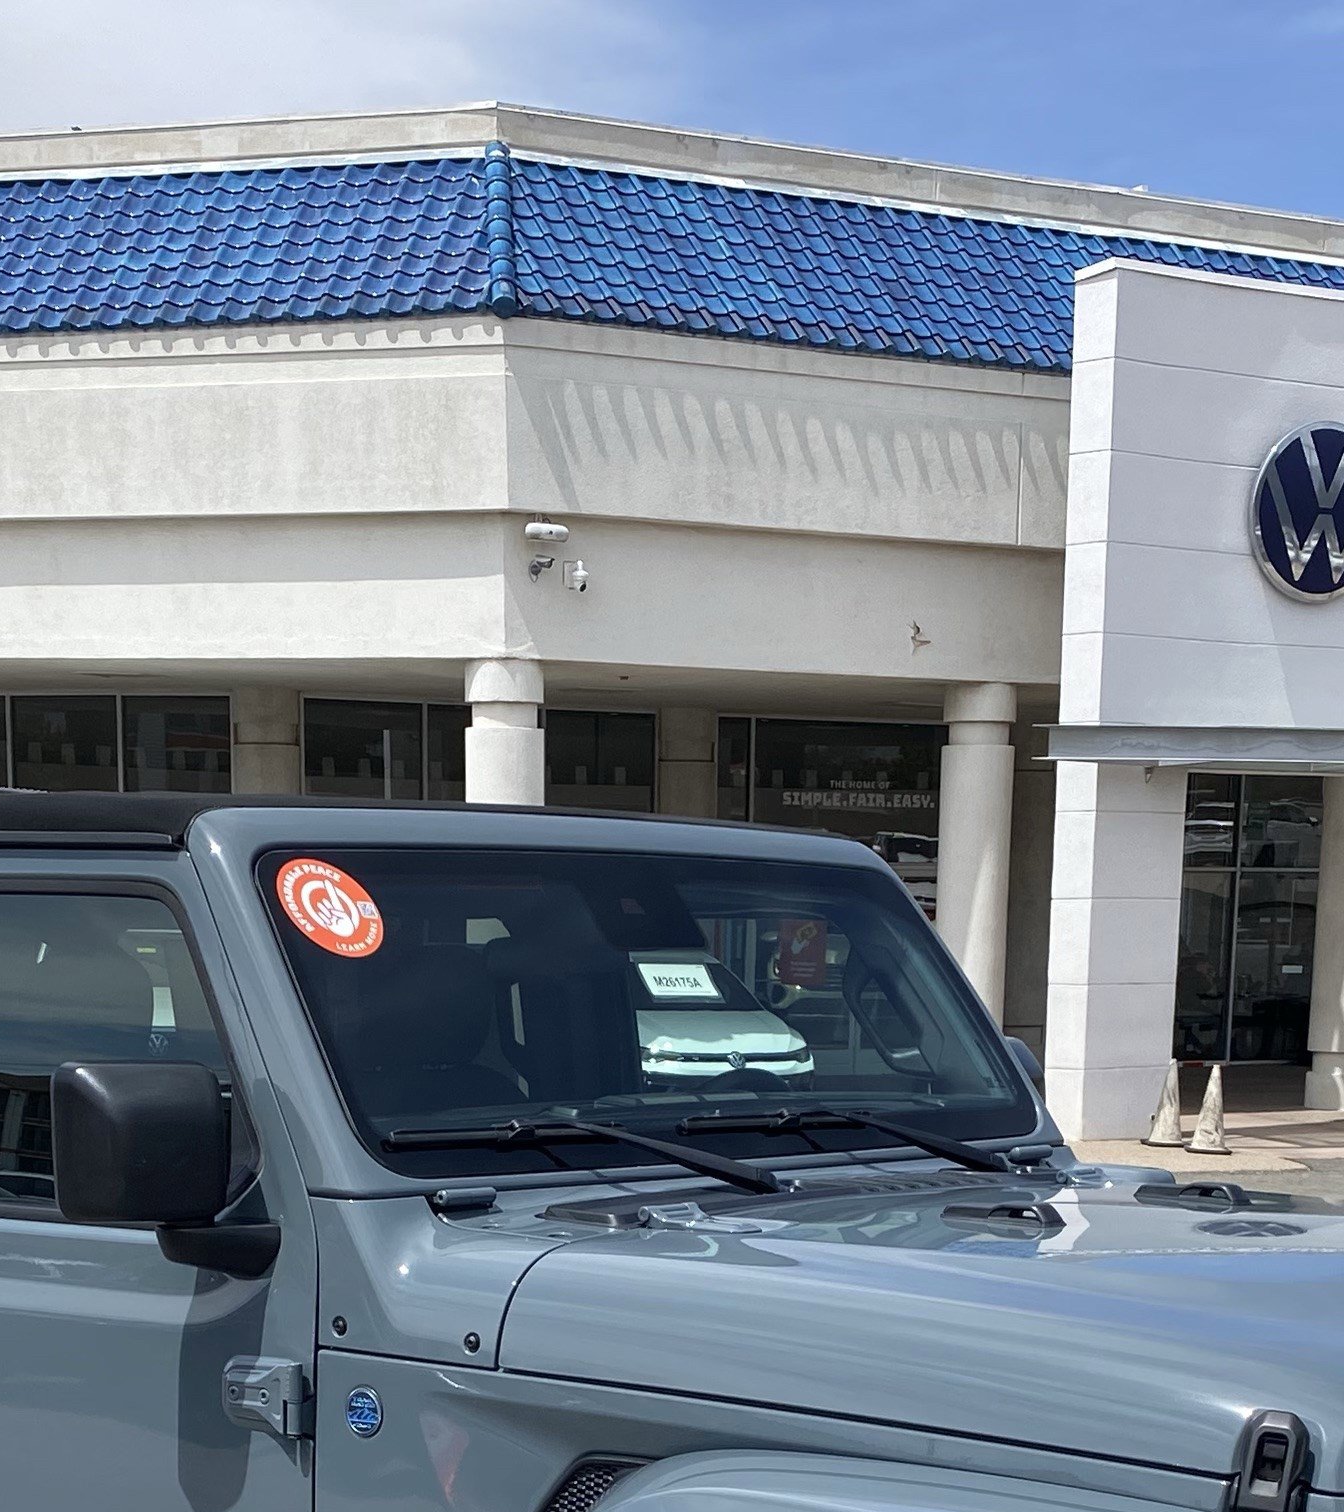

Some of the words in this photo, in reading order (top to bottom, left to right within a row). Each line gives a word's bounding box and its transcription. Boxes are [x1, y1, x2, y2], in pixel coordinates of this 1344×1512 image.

[830, 780, 847, 789] THE
[848, 780, 876, 789] HOME
[301, 863, 341, 883] PEACE
[336, 942, 367, 953] LEARN
[652, 975, 703, 989] M26175A
